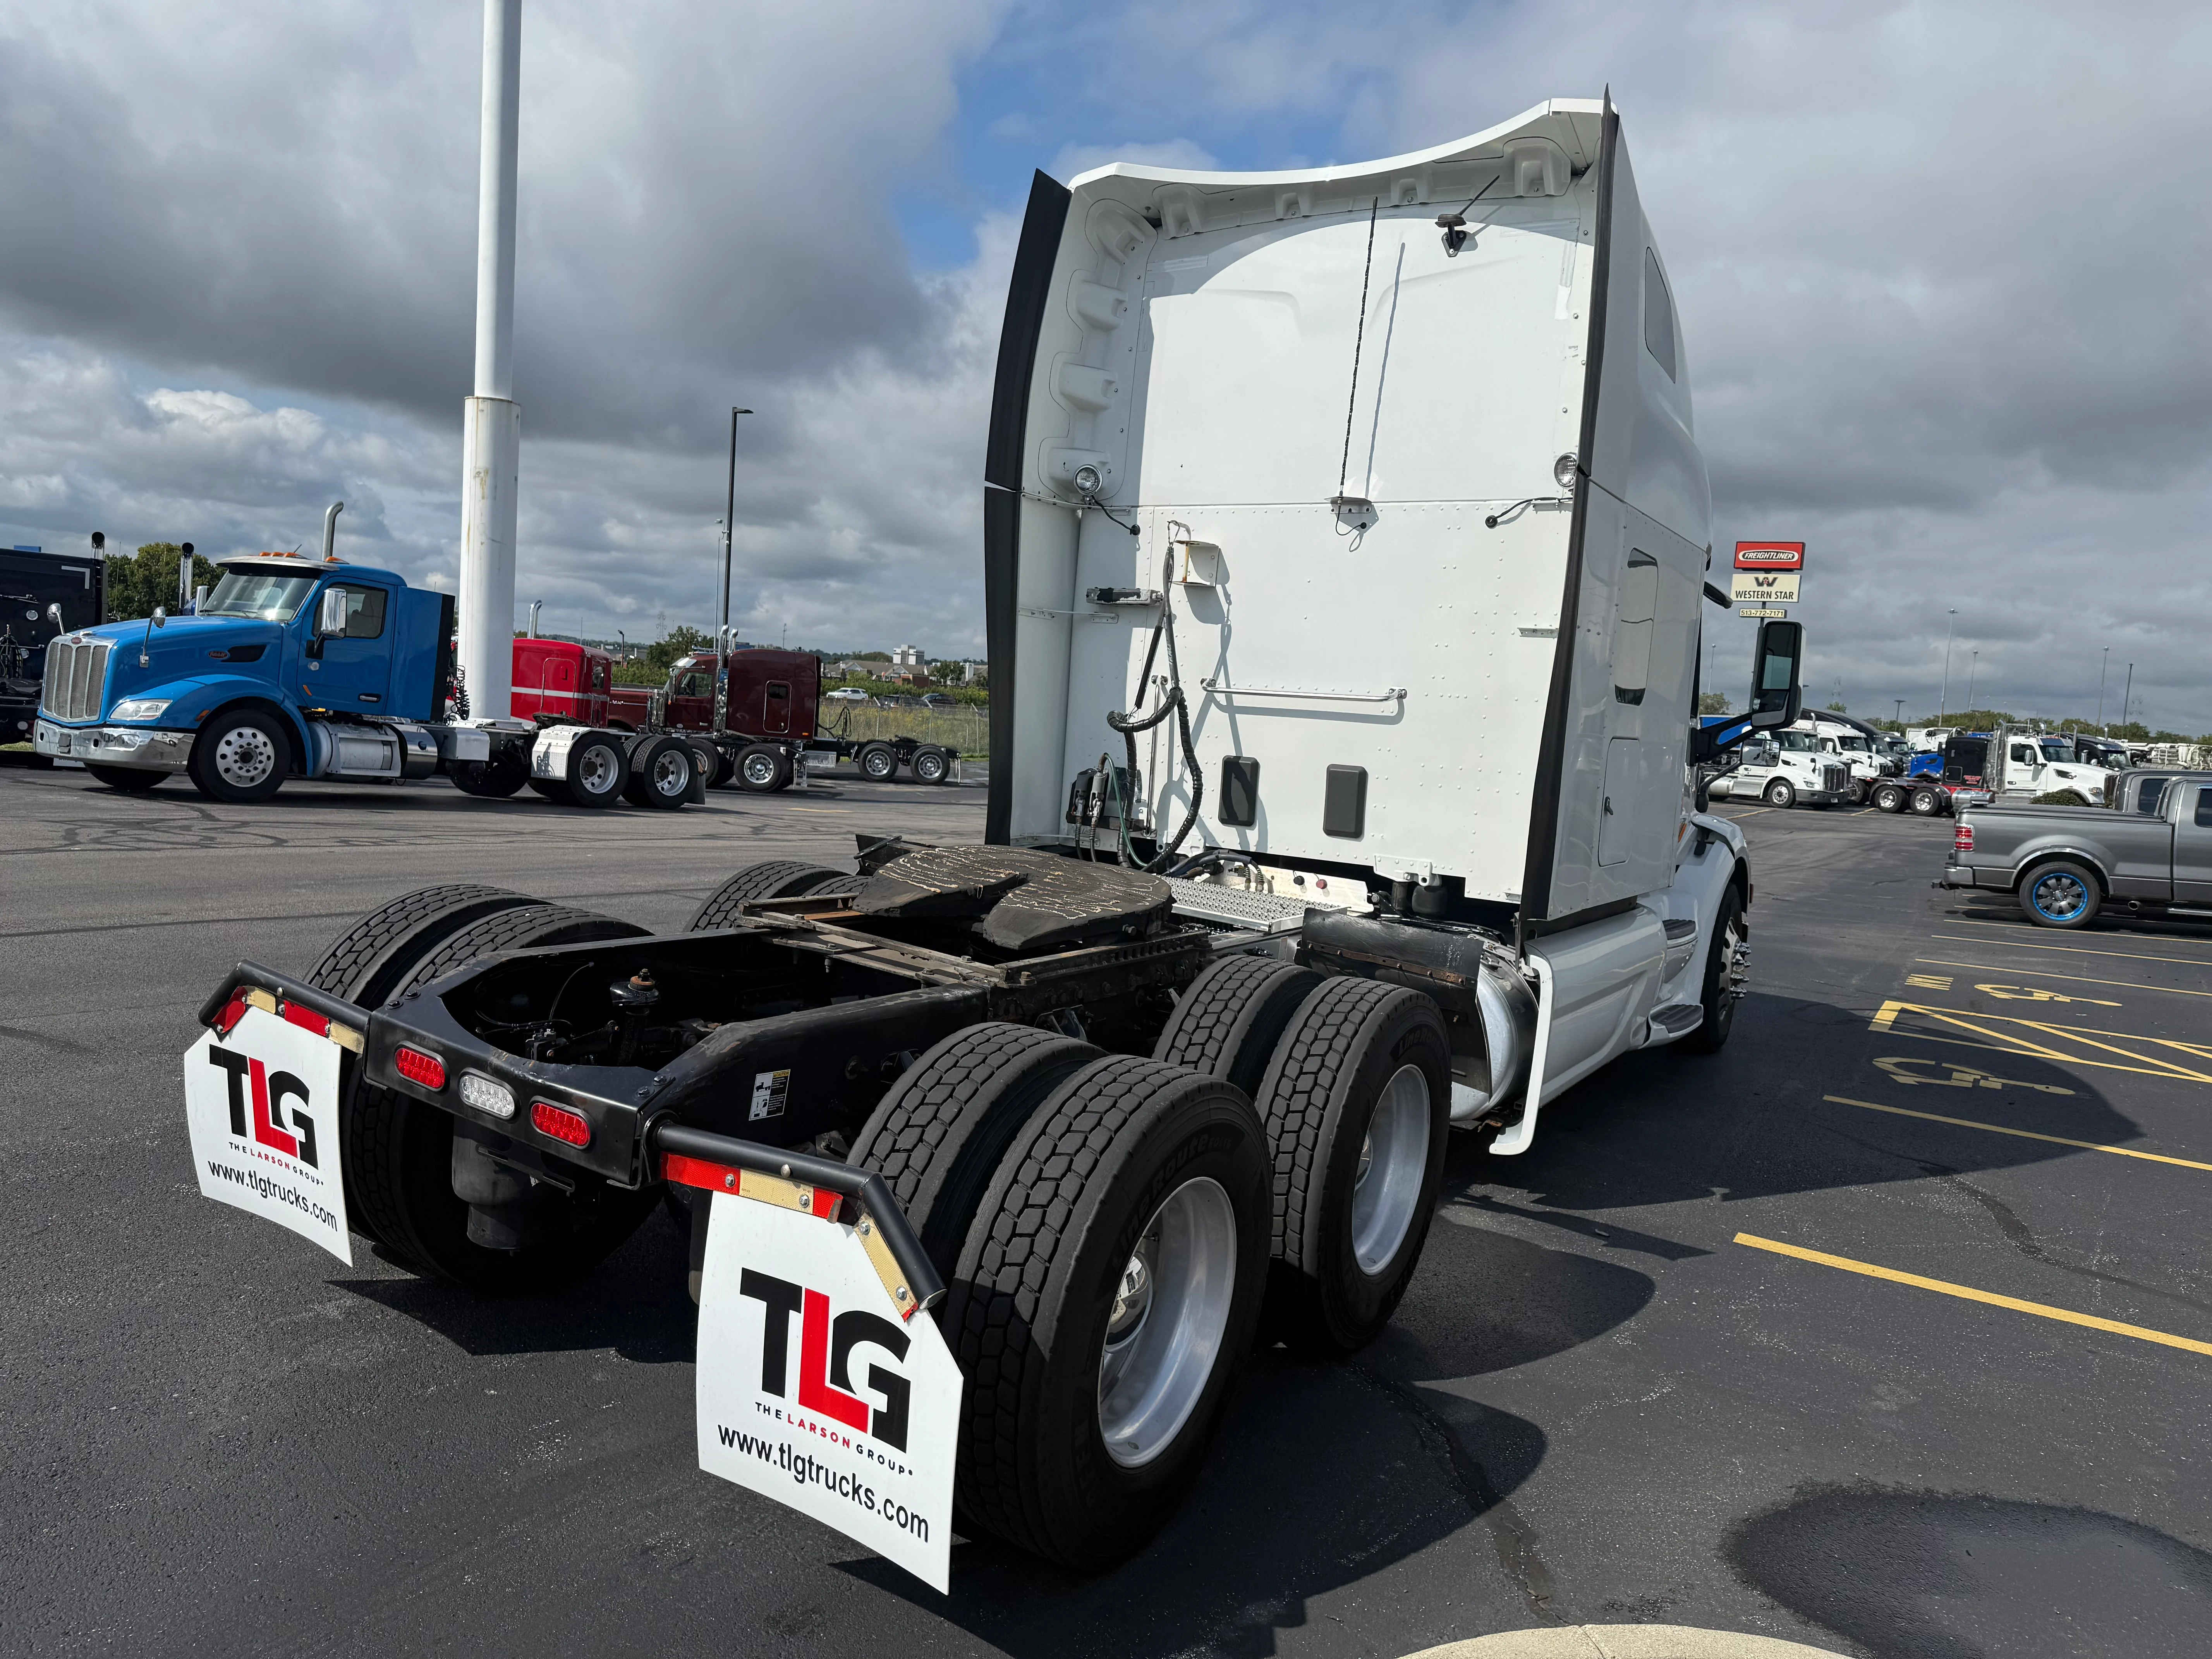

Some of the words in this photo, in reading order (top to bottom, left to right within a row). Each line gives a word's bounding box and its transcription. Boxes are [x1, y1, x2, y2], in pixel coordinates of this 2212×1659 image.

[1736, 591, 1772, 599] WESTERN
[1774, 591, 1794, 599] STAR
[209, 1044, 319, 1170] TLG
[229, 1142, 247, 1154] THE
[251, 1149, 290, 1170] LARSON
[208, 1161, 338, 1231] www.tlgtrucks.com
[740, 1267, 911, 1454] TLG
[756, 1402, 781, 1419] THE
[788, 1413, 850, 1449] LARSON
[718, 1424, 928, 1543] www.tlgtrucks.com
